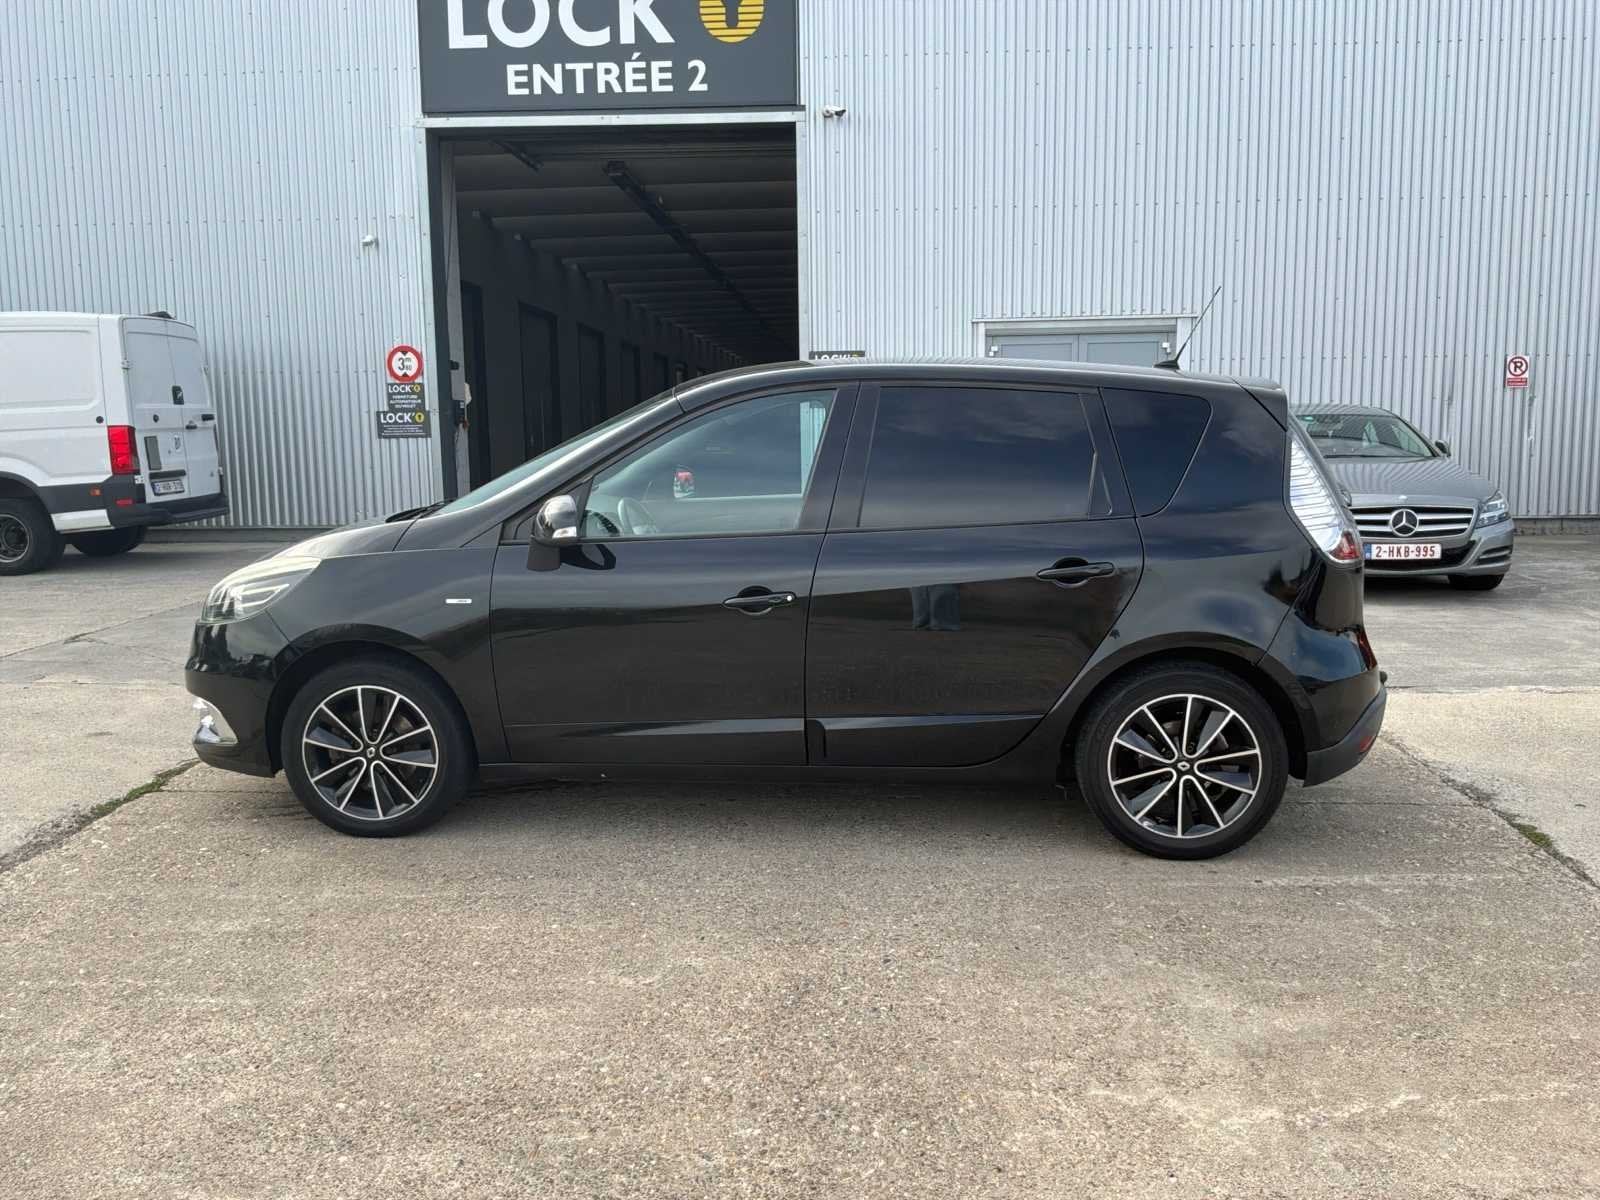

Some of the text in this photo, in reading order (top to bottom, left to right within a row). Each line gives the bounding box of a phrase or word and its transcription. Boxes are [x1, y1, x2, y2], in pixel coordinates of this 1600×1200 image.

[506, 52, 709, 96] ENTRÉE 2
[1375, 546, 1435, 558] 2-HKB-995
